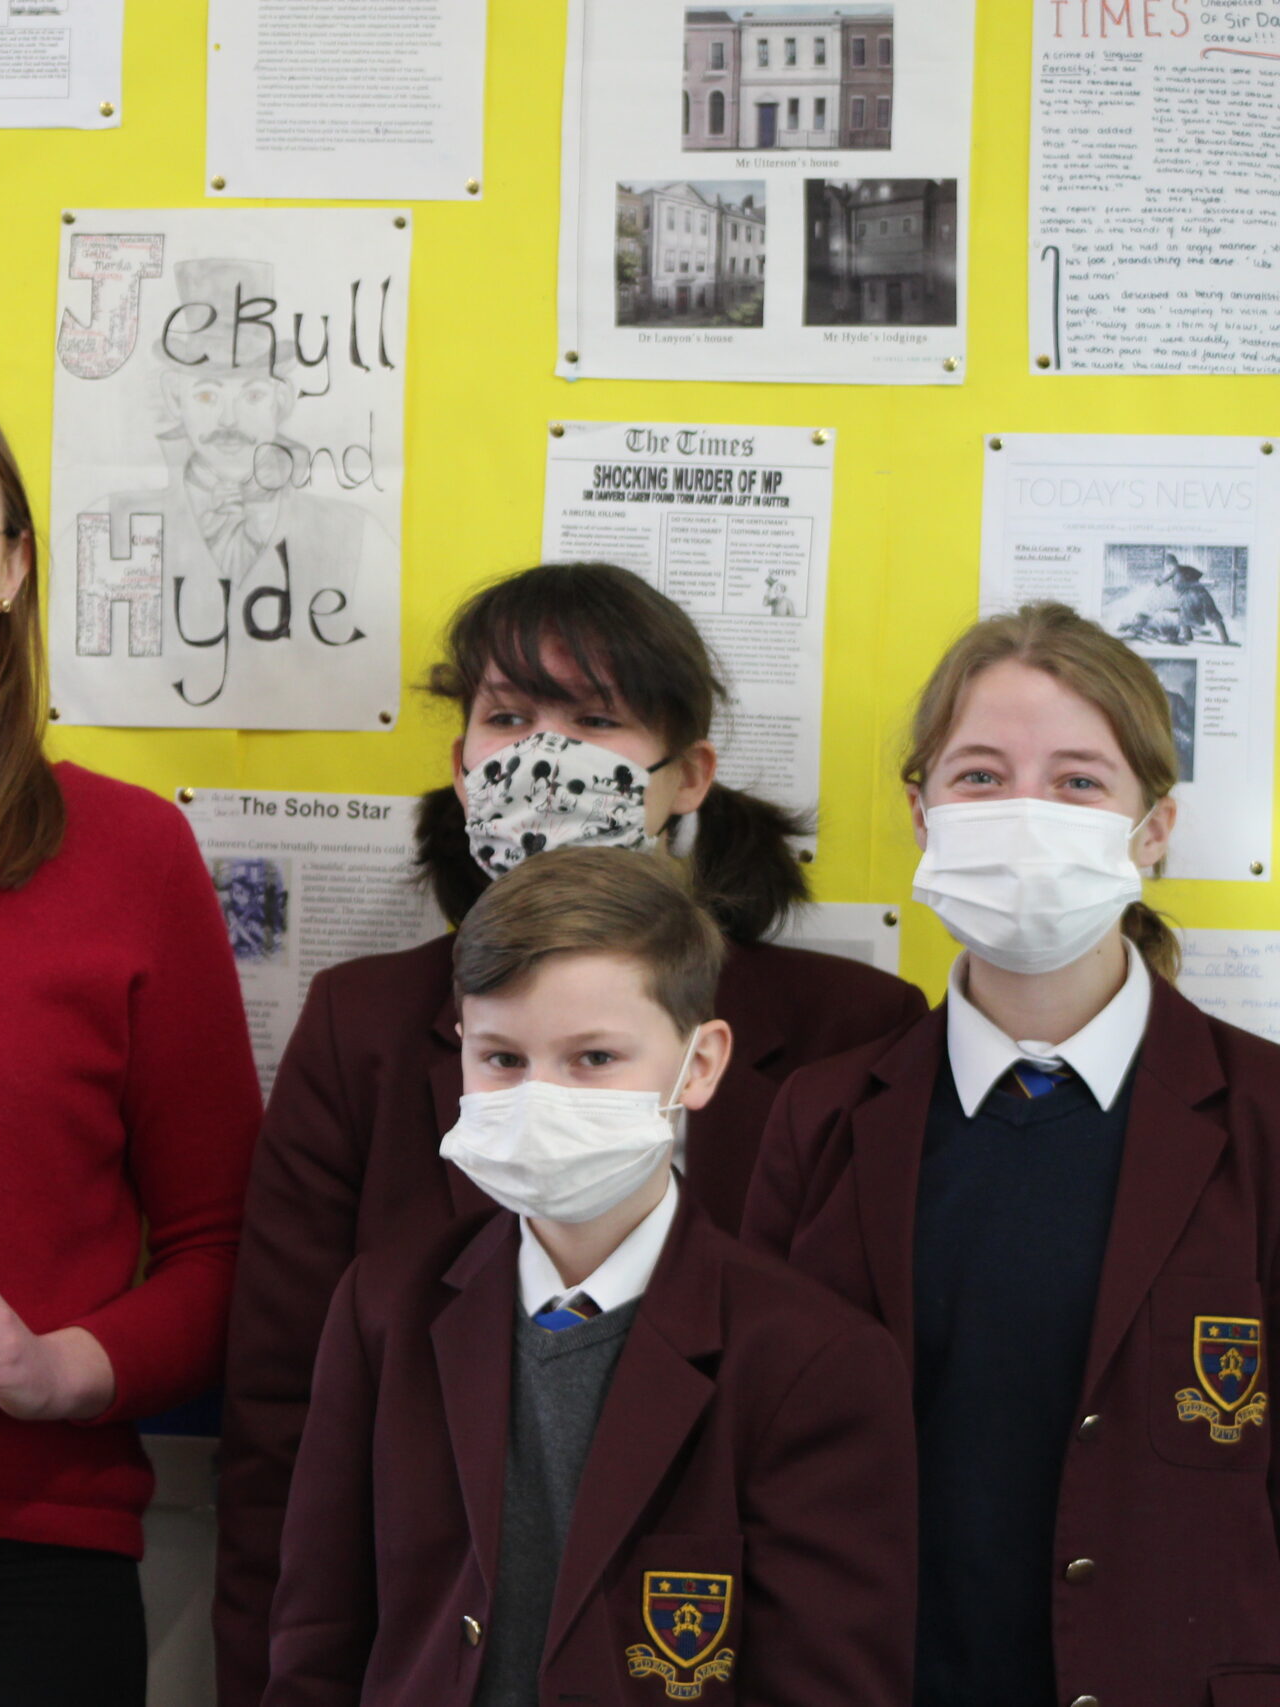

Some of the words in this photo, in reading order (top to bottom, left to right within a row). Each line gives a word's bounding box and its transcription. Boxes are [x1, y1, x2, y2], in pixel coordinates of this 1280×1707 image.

[1050, 0, 1190, 38] TIMES
[1224, 15, 1250, 28] Sir
[735, 158, 750, 168] Mr
[753, 157, 806, 168] Utterson's
[810, 158, 840, 168] house
[638, 333, 651, 343] Dr
[655, 332, 701, 345] Lanyon's
[704, 333, 733, 343] house
[823, 332, 838, 343] Mr
[842, 332, 879, 345] Hyde's
[882, 331, 928, 345] lodgings
[240, 409, 384, 491] and
[623, 428, 670, 454] The
[677, 429, 755, 457] Times
[593, 464, 668, 490] SHOCKING
[673, 468, 733, 493] MURDER
[738, 470, 757, 493] OF
[761, 470, 782, 494] MP
[595, 491, 625, 502] DANVERS
[627, 492, 650, 502] CAREW
[652, 493, 674, 503] FOUND
[676, 494, 694, 504] TORN
[696, 495, 718, 505] APART
[719, 495, 734, 505] AND
[734, 496, 751, 506] LEFT
[753, 497, 761, 507] IN
[762, 497, 790, 508] GUTTER
[1013, 477, 1145, 509] TODAY'S
[1156, 481, 1253, 511] NEWS
[76, 513, 367, 707] Hyde
[239, 796, 277, 816] The
[284, 799, 339, 818] Soho
[347, 801, 391, 820] Star
[207, 839, 246, 849] Danvers
[248, 840, 278, 849] Carew
[280, 841, 319, 852] brutally
[321, 843, 370, 853] murdered
[371, 845, 382, 854] in
[383, 846, 405, 855] cold
[670, 1686, 698, 1696] VITA
